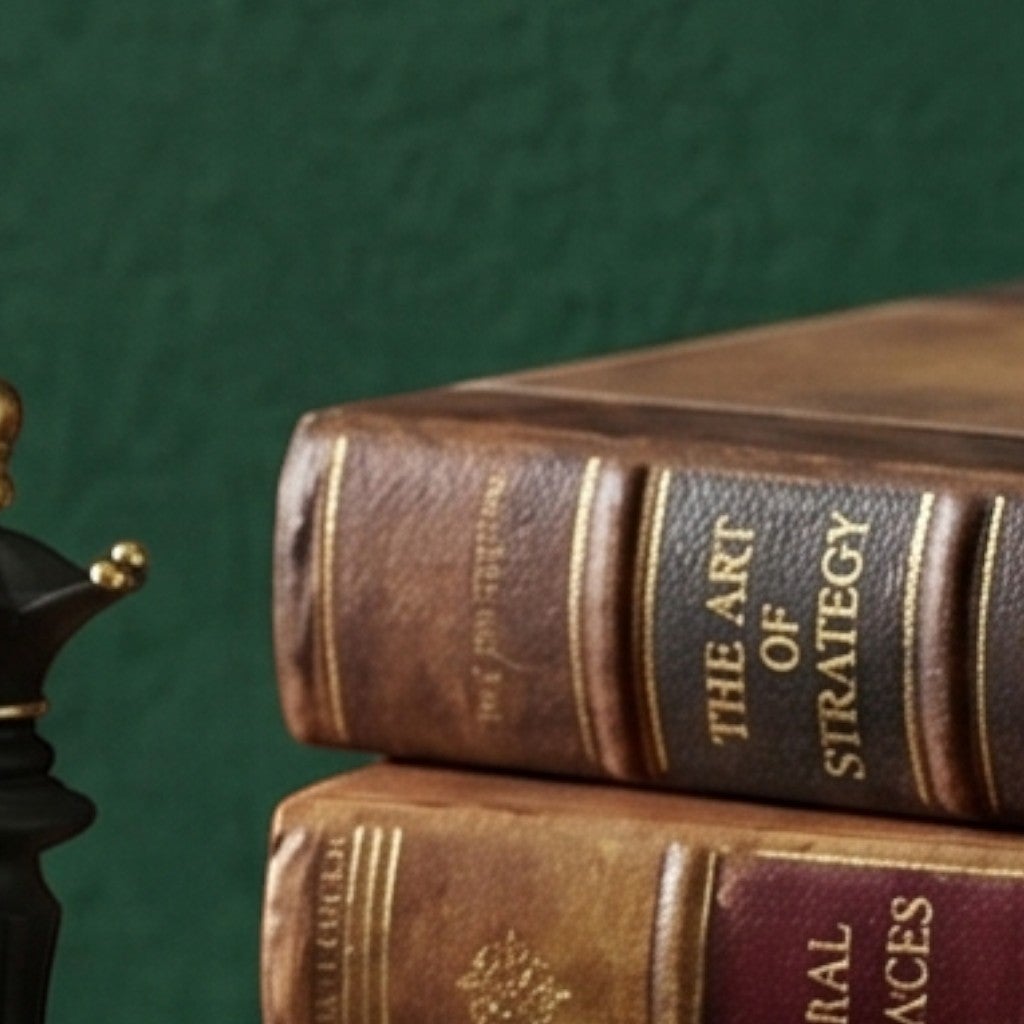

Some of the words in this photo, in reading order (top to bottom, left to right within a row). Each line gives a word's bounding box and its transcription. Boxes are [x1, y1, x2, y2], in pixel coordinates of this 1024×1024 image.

[706, 514, 755, 626] ART
[760, 603, 800, 672] OF
[816, 511, 870, 780] STRATEGY
[705, 641, 748, 745] THE
